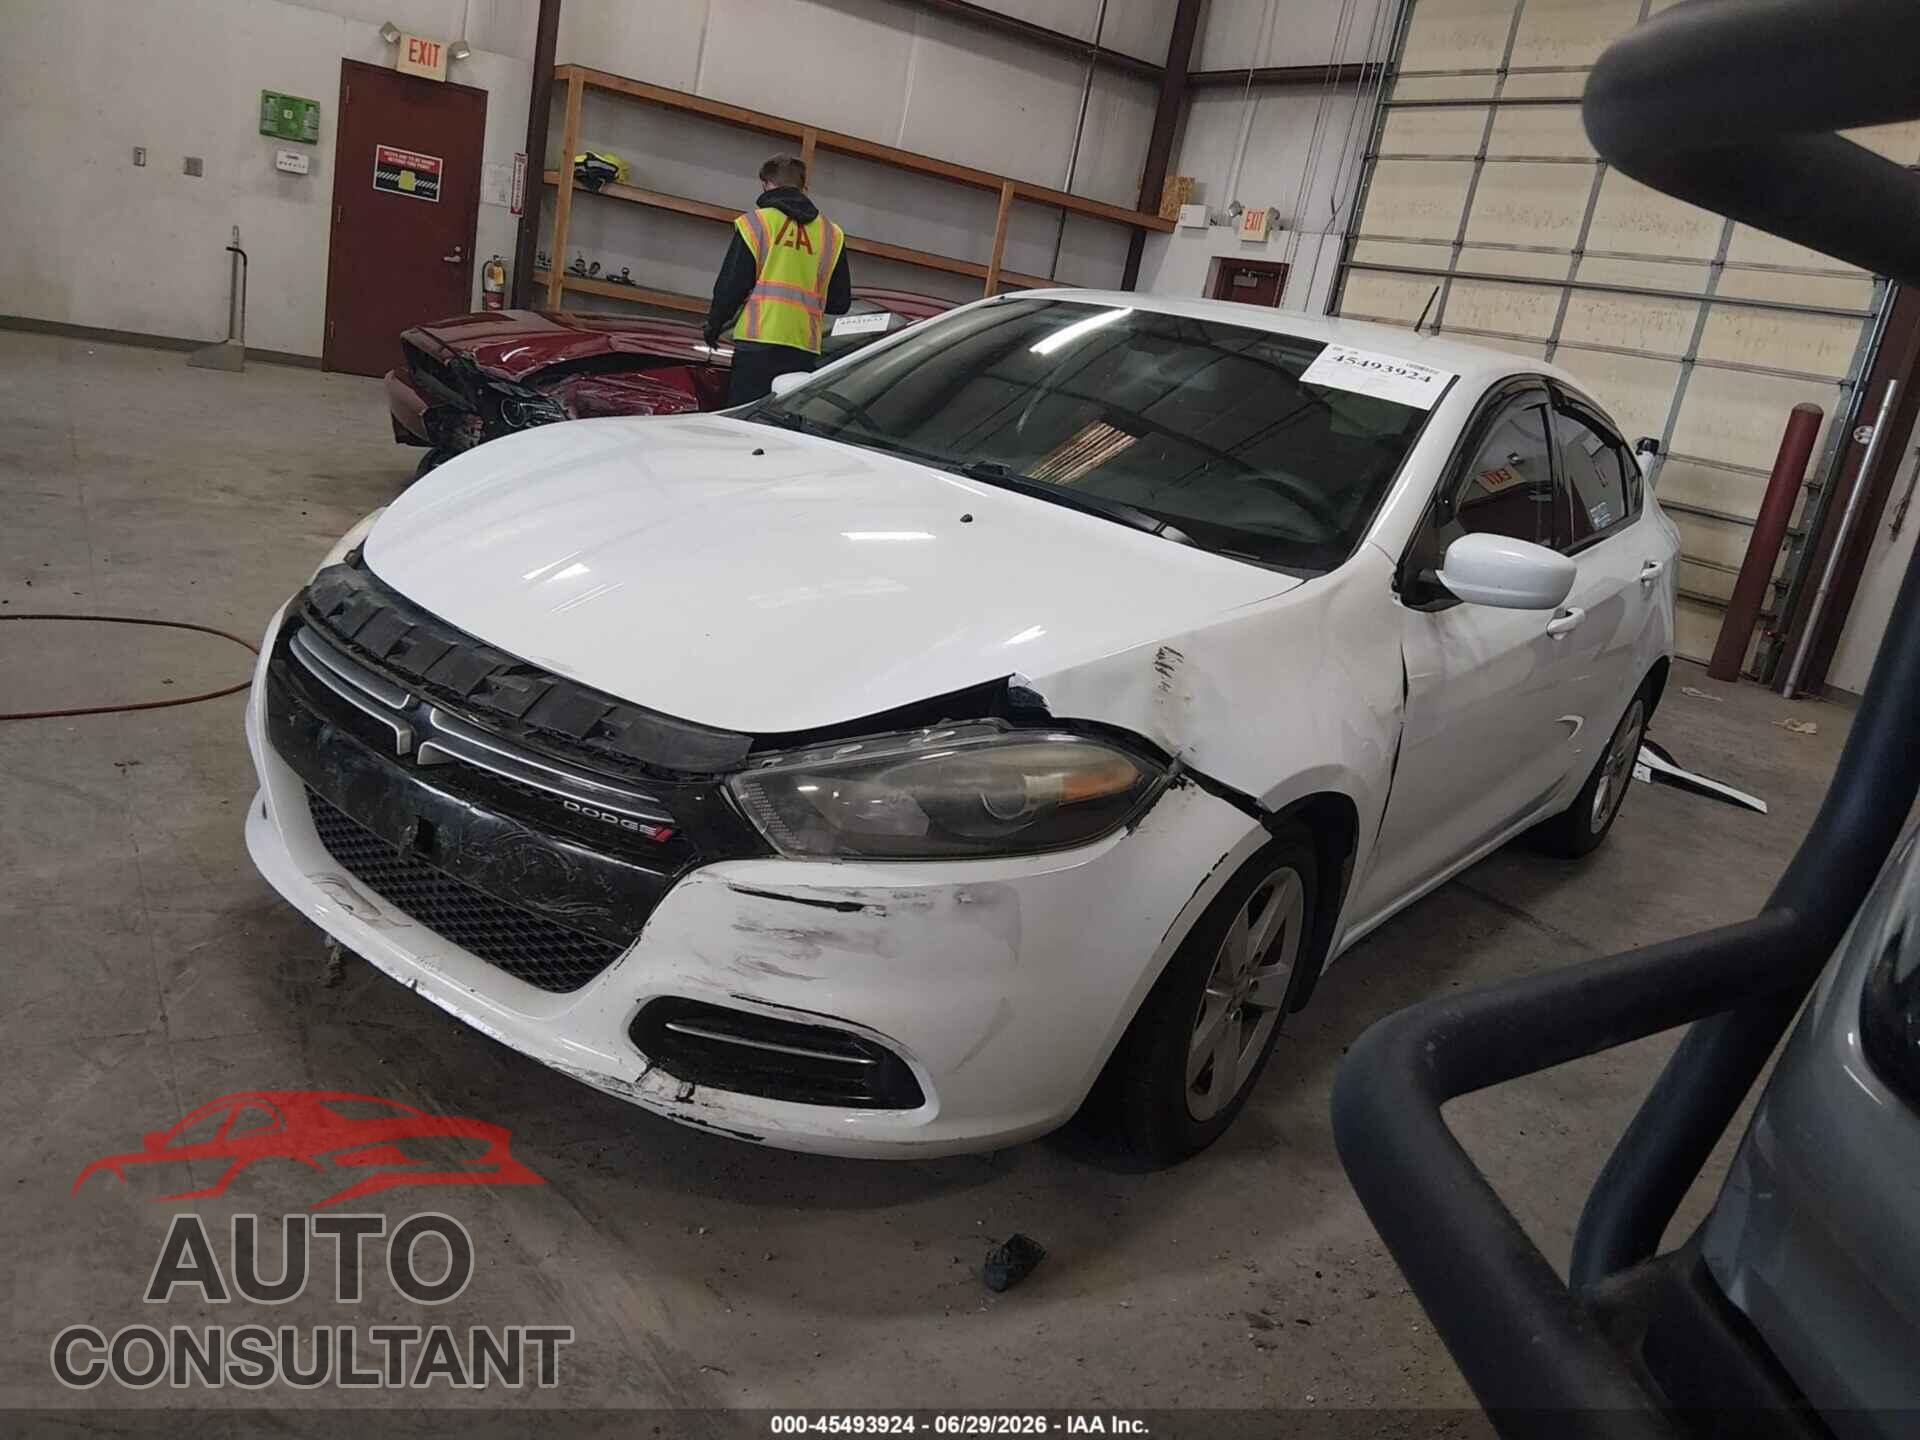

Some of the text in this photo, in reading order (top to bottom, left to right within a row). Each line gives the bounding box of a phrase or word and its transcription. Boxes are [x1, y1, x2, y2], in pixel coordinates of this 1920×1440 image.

[408, 38, 441, 68] EXIT
[1244, 211, 1265, 232] EXIT
[1333, 354, 1432, 383] 45493924
[563, 799, 657, 838] DODGE
